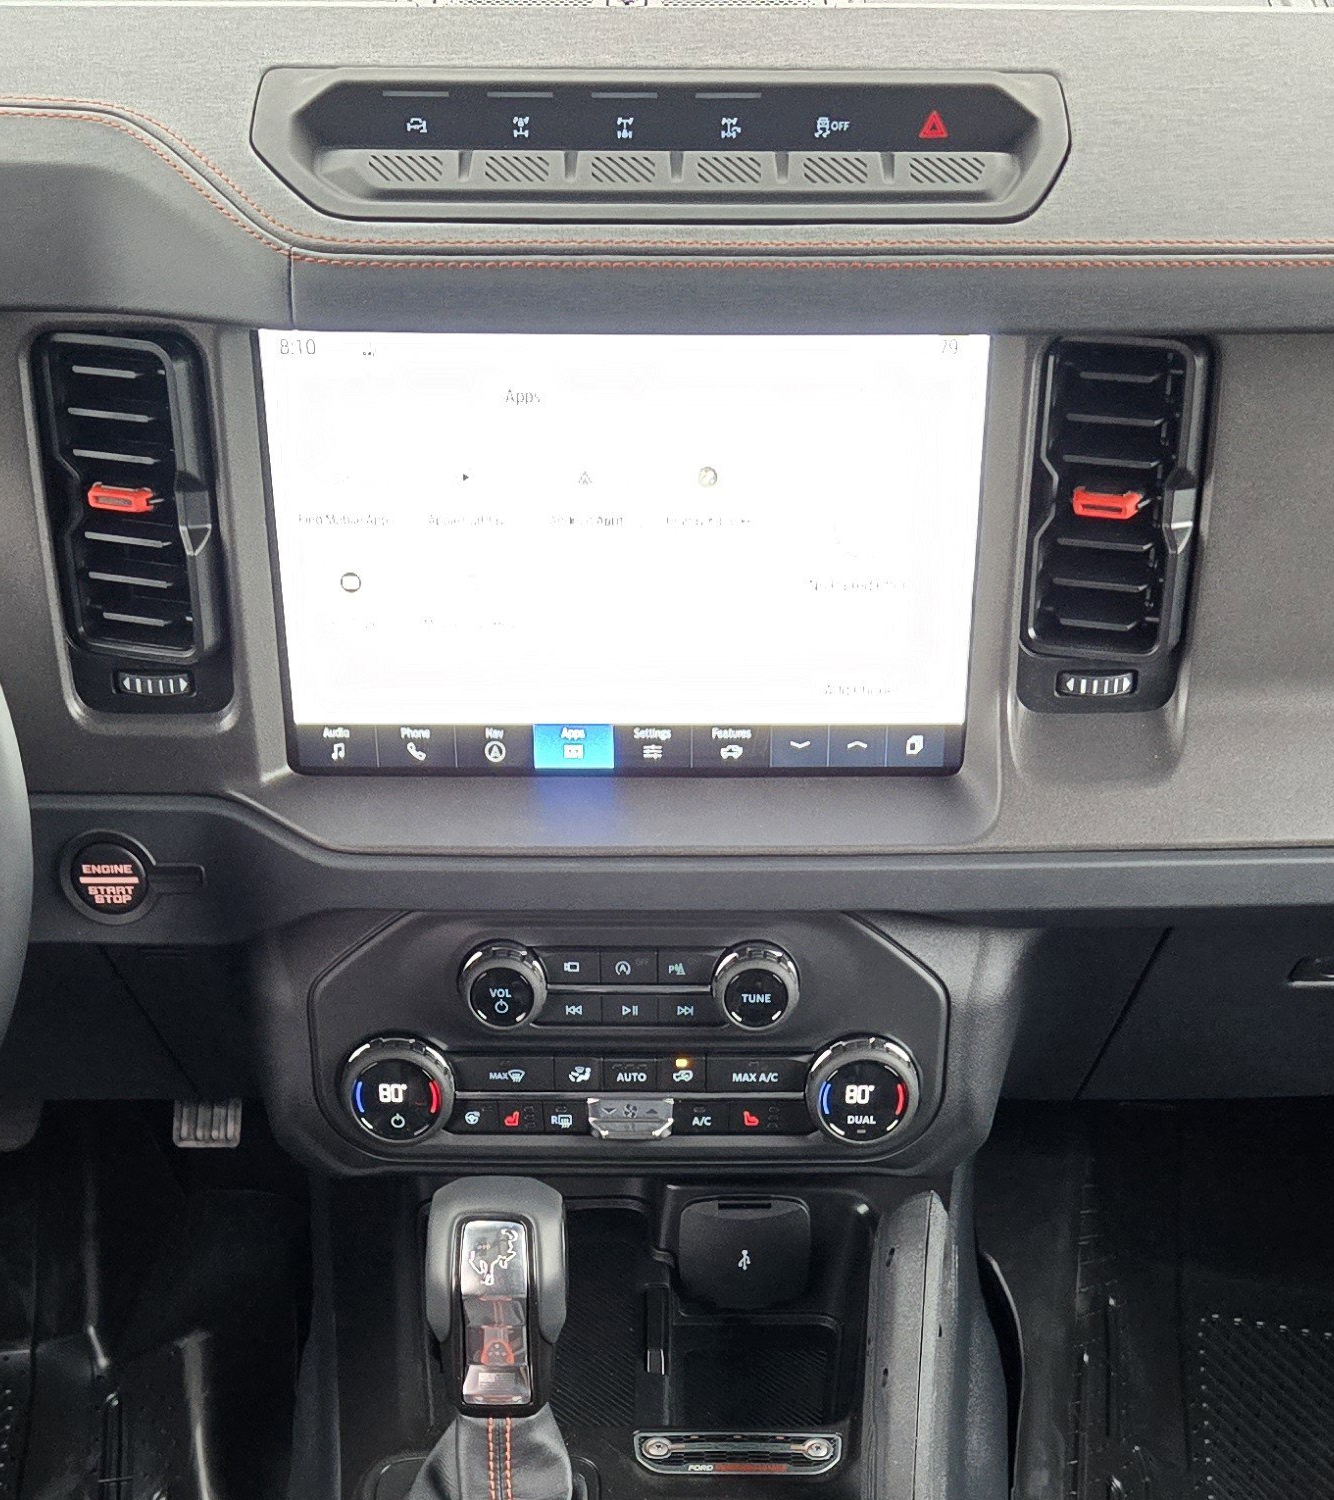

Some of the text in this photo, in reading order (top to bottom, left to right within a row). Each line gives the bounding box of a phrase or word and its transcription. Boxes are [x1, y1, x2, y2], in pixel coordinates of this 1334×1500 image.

[831, 121, 850, 131] OFF
[279, 338, 316, 355] 8:10
[505, 388, 541, 405] Apps
[323, 727, 350, 739] Audio
[400, 727, 431, 739] Phone
[485, 727, 504, 739] Nav
[560, 727, 586, 740] Apps
[633, 727, 672, 741] Settings
[711, 727, 752, 740] Features
[82, 864, 133, 874] ENGINE
[88, 886, 134, 895] START
[95, 895, 132, 904] STOP
[489, 988, 512, 999] VOL
[741, 993, 772, 1004] TUNE
[489, 1070, 509, 1081] MAX
[616, 1072, 647, 1083] AUTO
[732, 1072, 779, 1083] MAX A/C
[692, 1116, 712, 1127] A/C
[847, 1115, 876, 1125] DUAL
